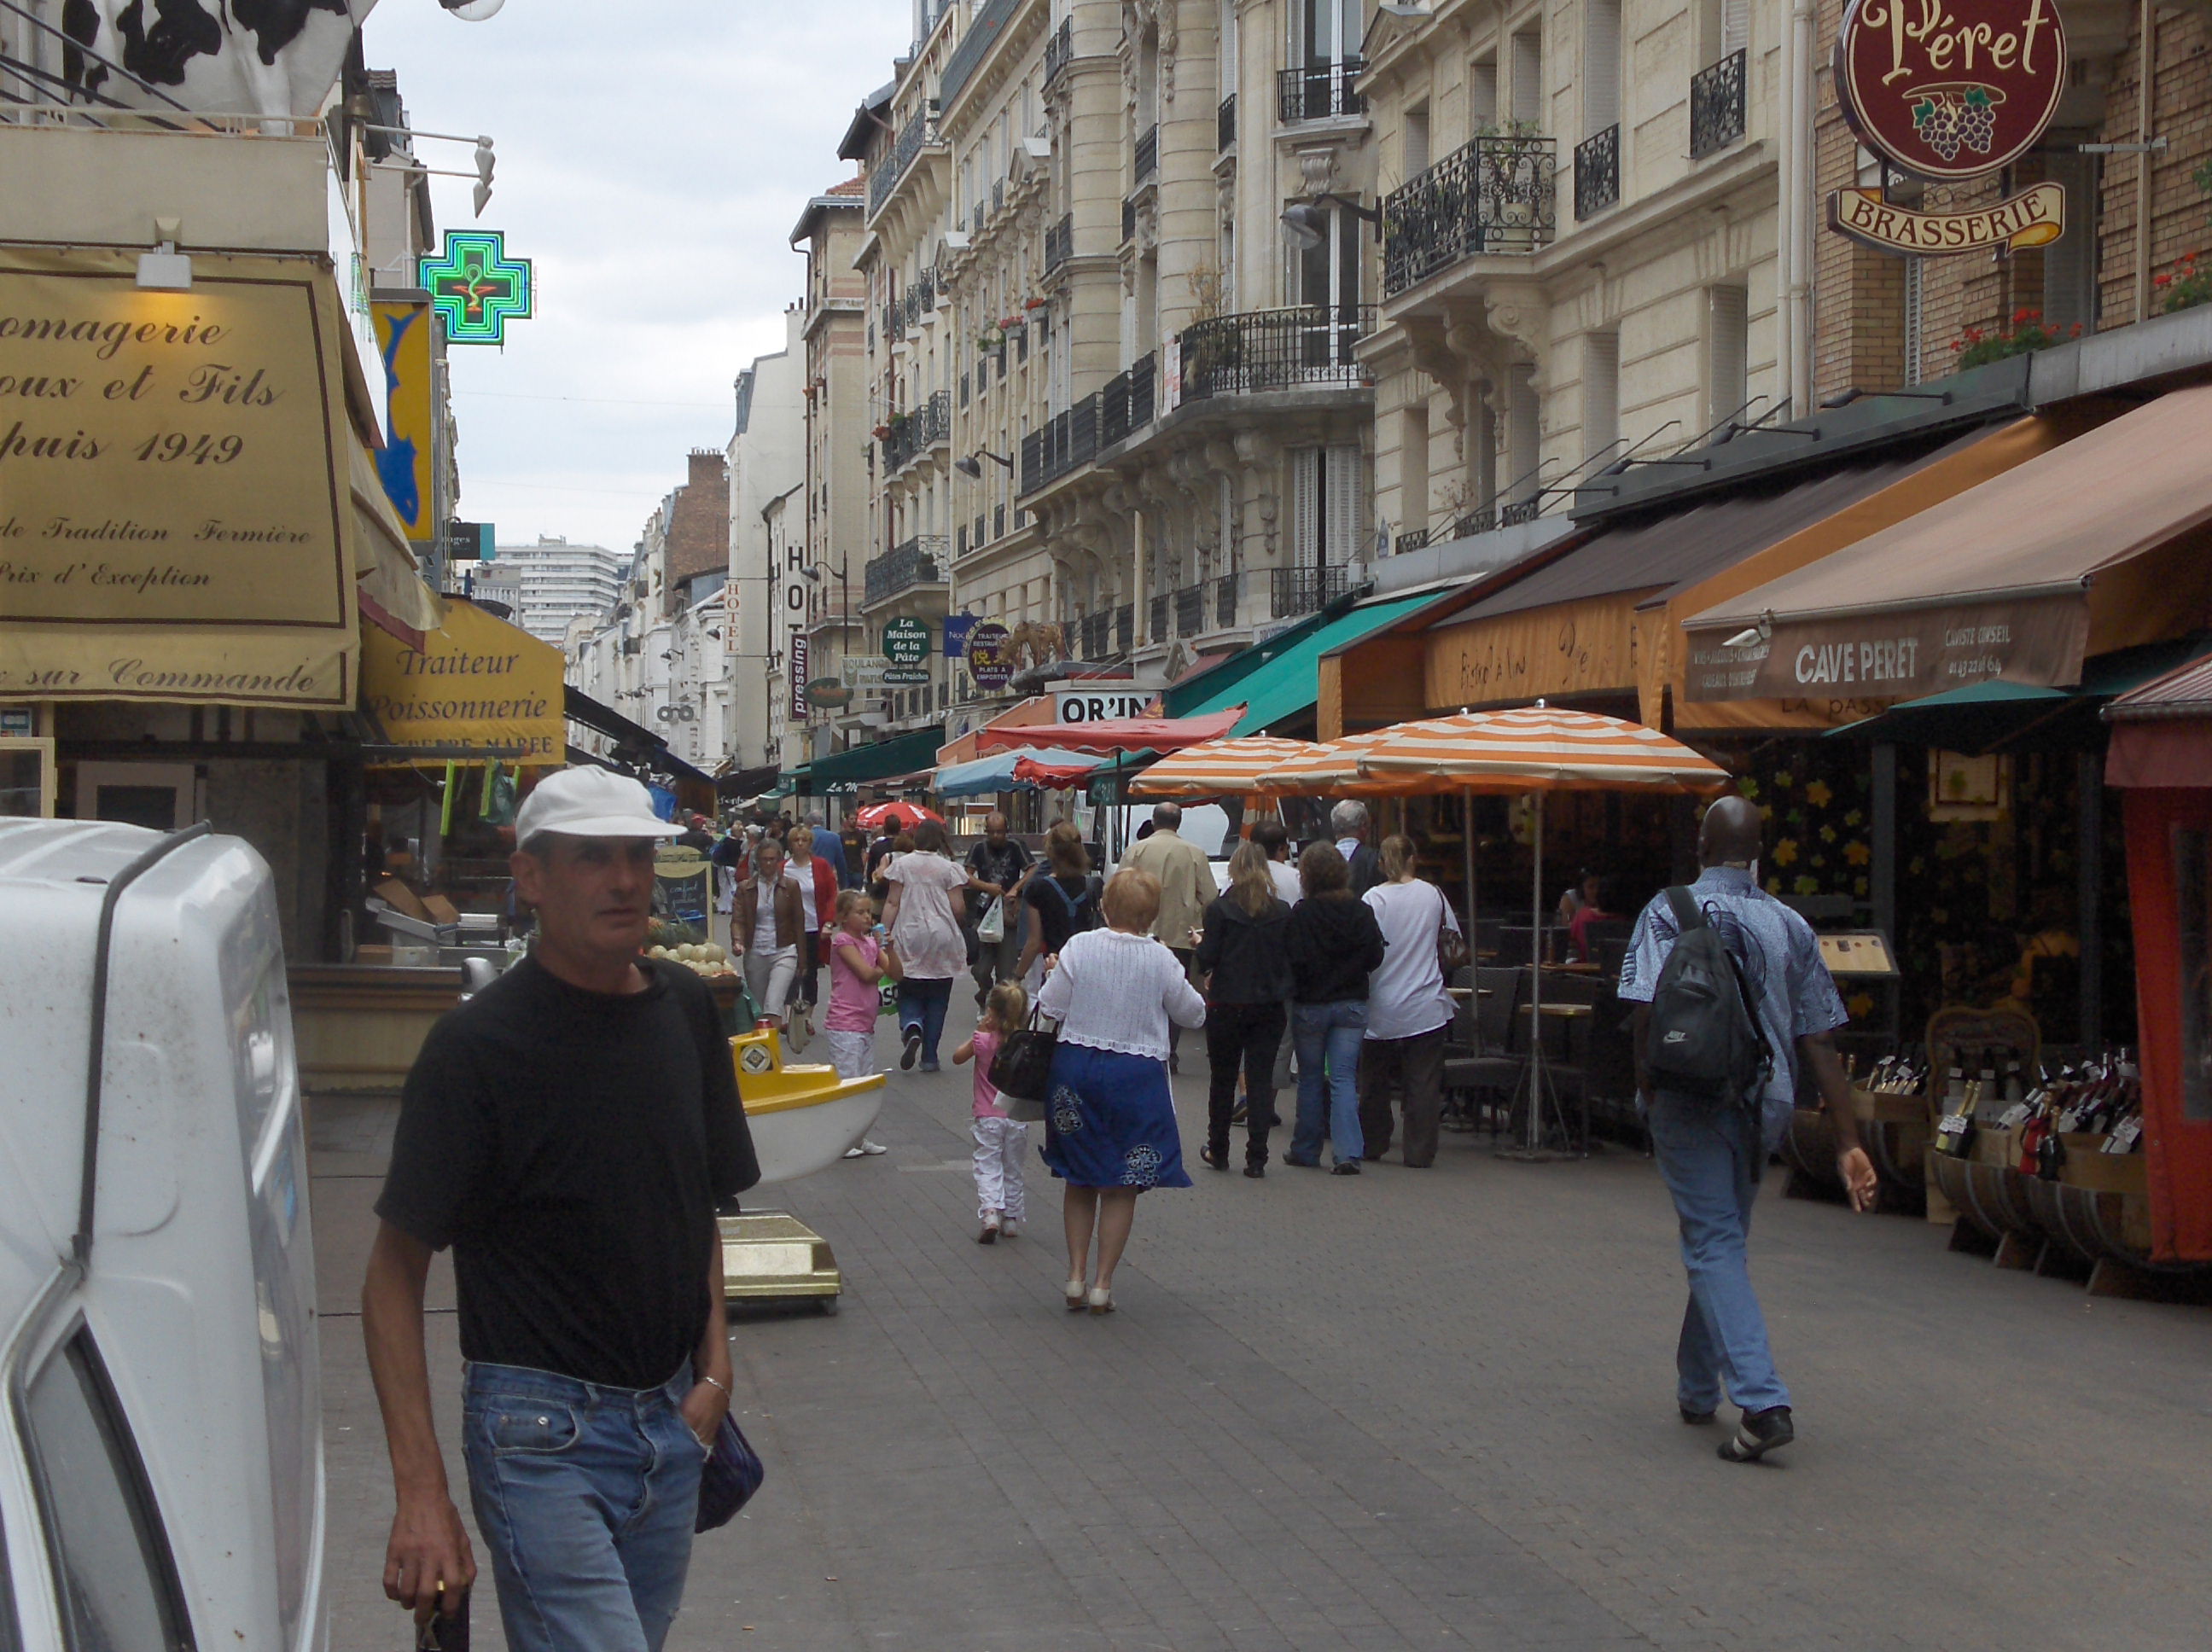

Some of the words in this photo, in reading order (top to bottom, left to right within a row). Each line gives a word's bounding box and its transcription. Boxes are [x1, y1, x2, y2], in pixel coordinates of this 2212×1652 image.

[1860, 0, 2050, 85] Péret
[1849, 192, 2047, 246] BRASSERIE
[0, 315, 232, 361] omagerie
[102, 364, 157, 400] et
[179, 363, 287, 406] Fils
[0, 421, 111, 463] puis
[133, 431, 244, 465] 1949
[42, 516, 169, 541] Tradition
[194, 519, 312, 544] Fermière
[727, 583, 740, 652] HOTEL
[899, 619, 914, 628] La
[887, 630, 927, 639] Maison
[894, 642, 906, 651] de
[909, 642, 921, 651] la
[1977, 625, 2011, 643] CONSEIL
[395, 647, 520, 676] Traiteur
[894, 652, 919, 662] Pâte
[1796, 643, 1856, 684] CAVE
[1860, 637, 1918, 681] PERET
[25, 669, 84, 685] sur
[108, 658, 319, 694] Commande
[795, 637, 806, 714] pressing
[372, 690, 547, 721] Poissonnerie
[1781, 697, 1810, 714] LA
[826, 782, 842, 793] La
